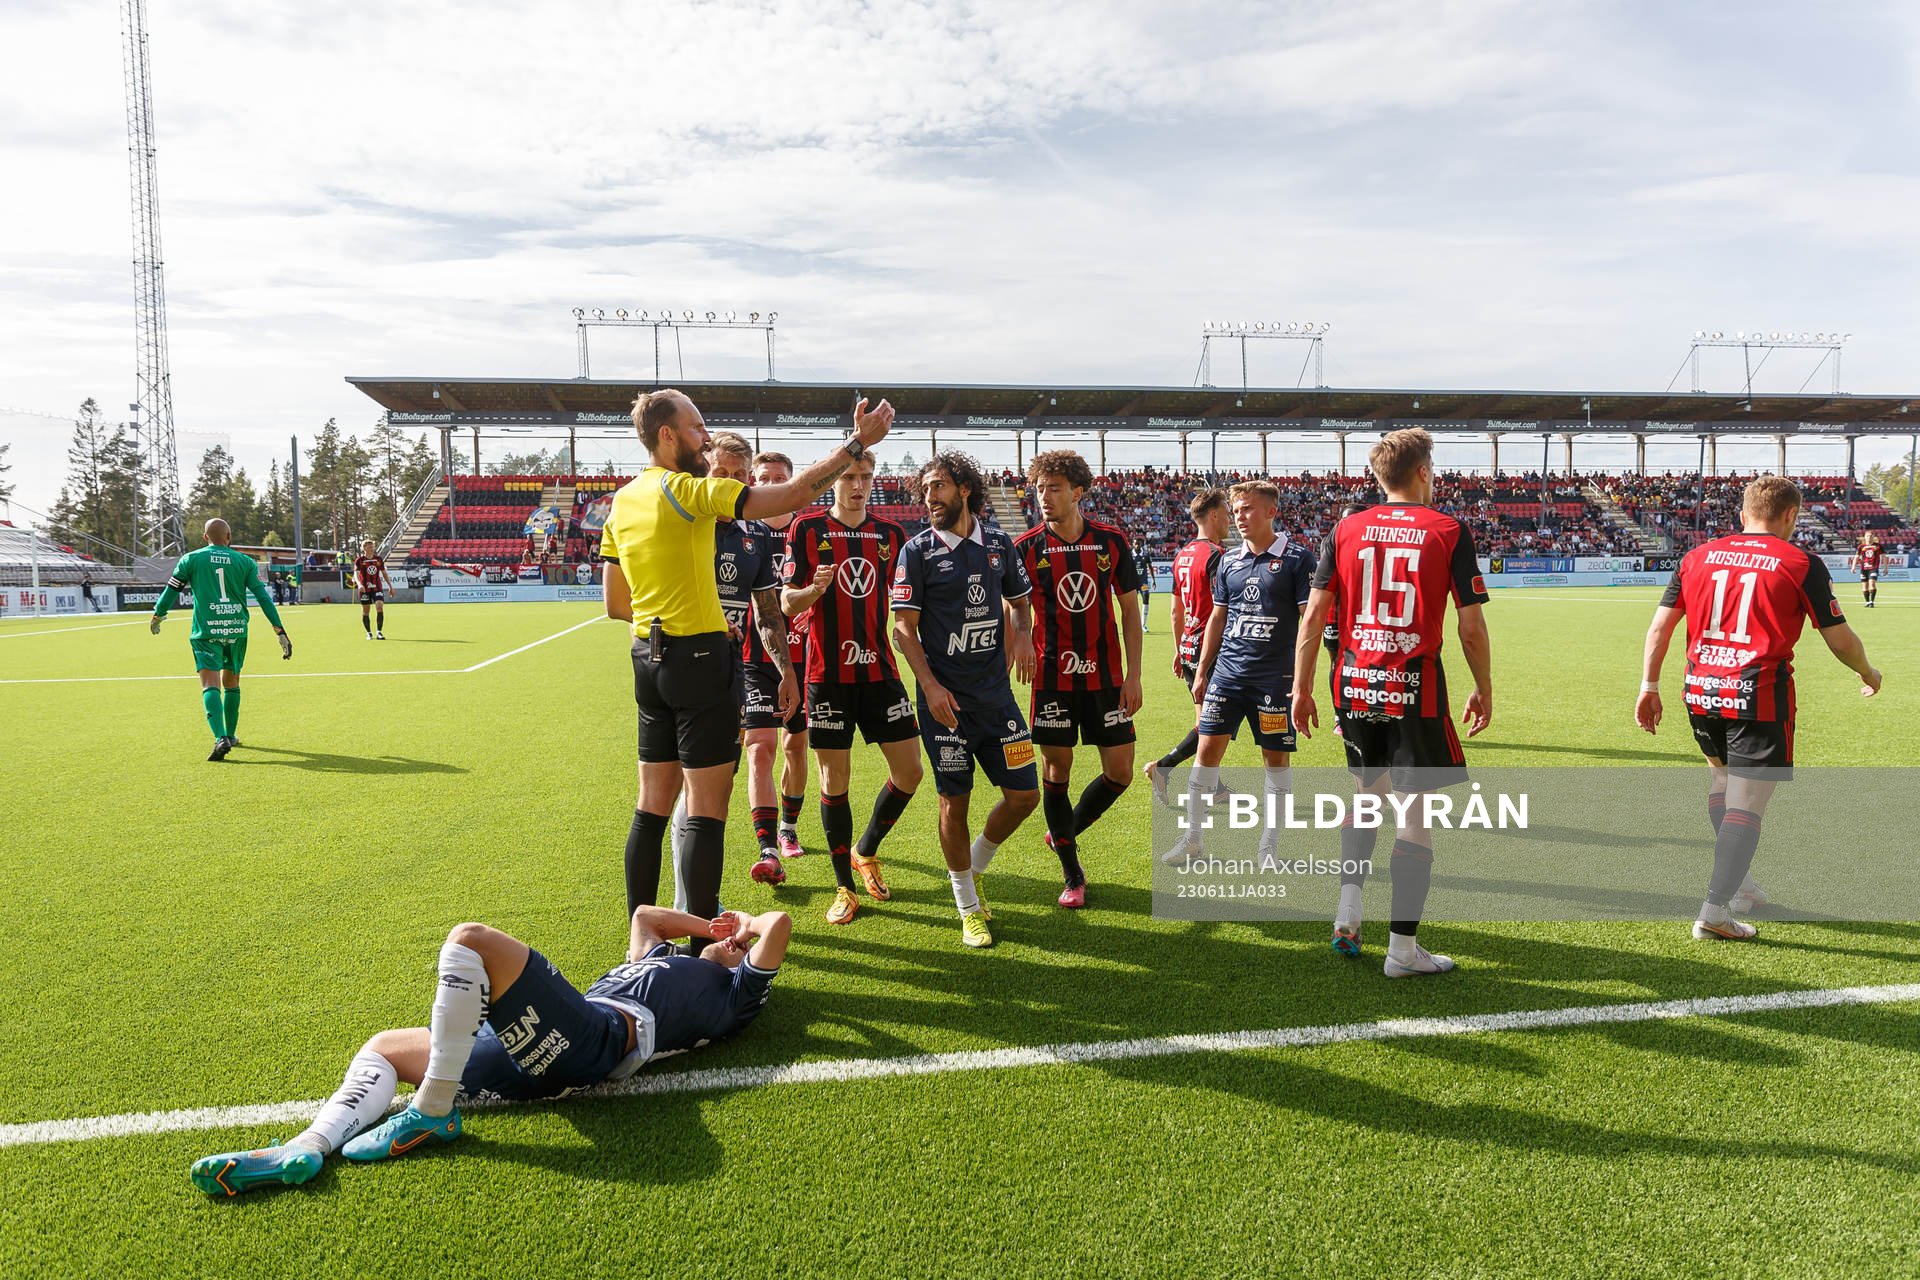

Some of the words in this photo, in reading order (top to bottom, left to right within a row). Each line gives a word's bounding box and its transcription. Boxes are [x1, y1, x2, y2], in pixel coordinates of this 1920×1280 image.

[390, 411, 451, 423] Bilbolaget.com
[576, 412, 634, 424] Bilbolaget.co
[1361, 525, 1428, 545] JOHNSON
[210, 556, 231, 564] KEITA
[1705, 550, 1781, 572] MUSOLITIN
[215, 568, 230, 602] 1
[1356, 546, 1421, 627] 15
[1703, 569, 1758, 644] 11
[1352, 625, 1394, 641] ÖSTER
[841, 640, 877, 665] Diös
[1360, 640, 1398, 653] SUND
[1060, 651, 1096, 674] Diös
[1700, 654, 1737, 668] SUND
[1342, 665, 1420, 687] wangeskog
[1343, 686, 1415, 705] engcon
[1685, 692, 1747, 709] engcon
